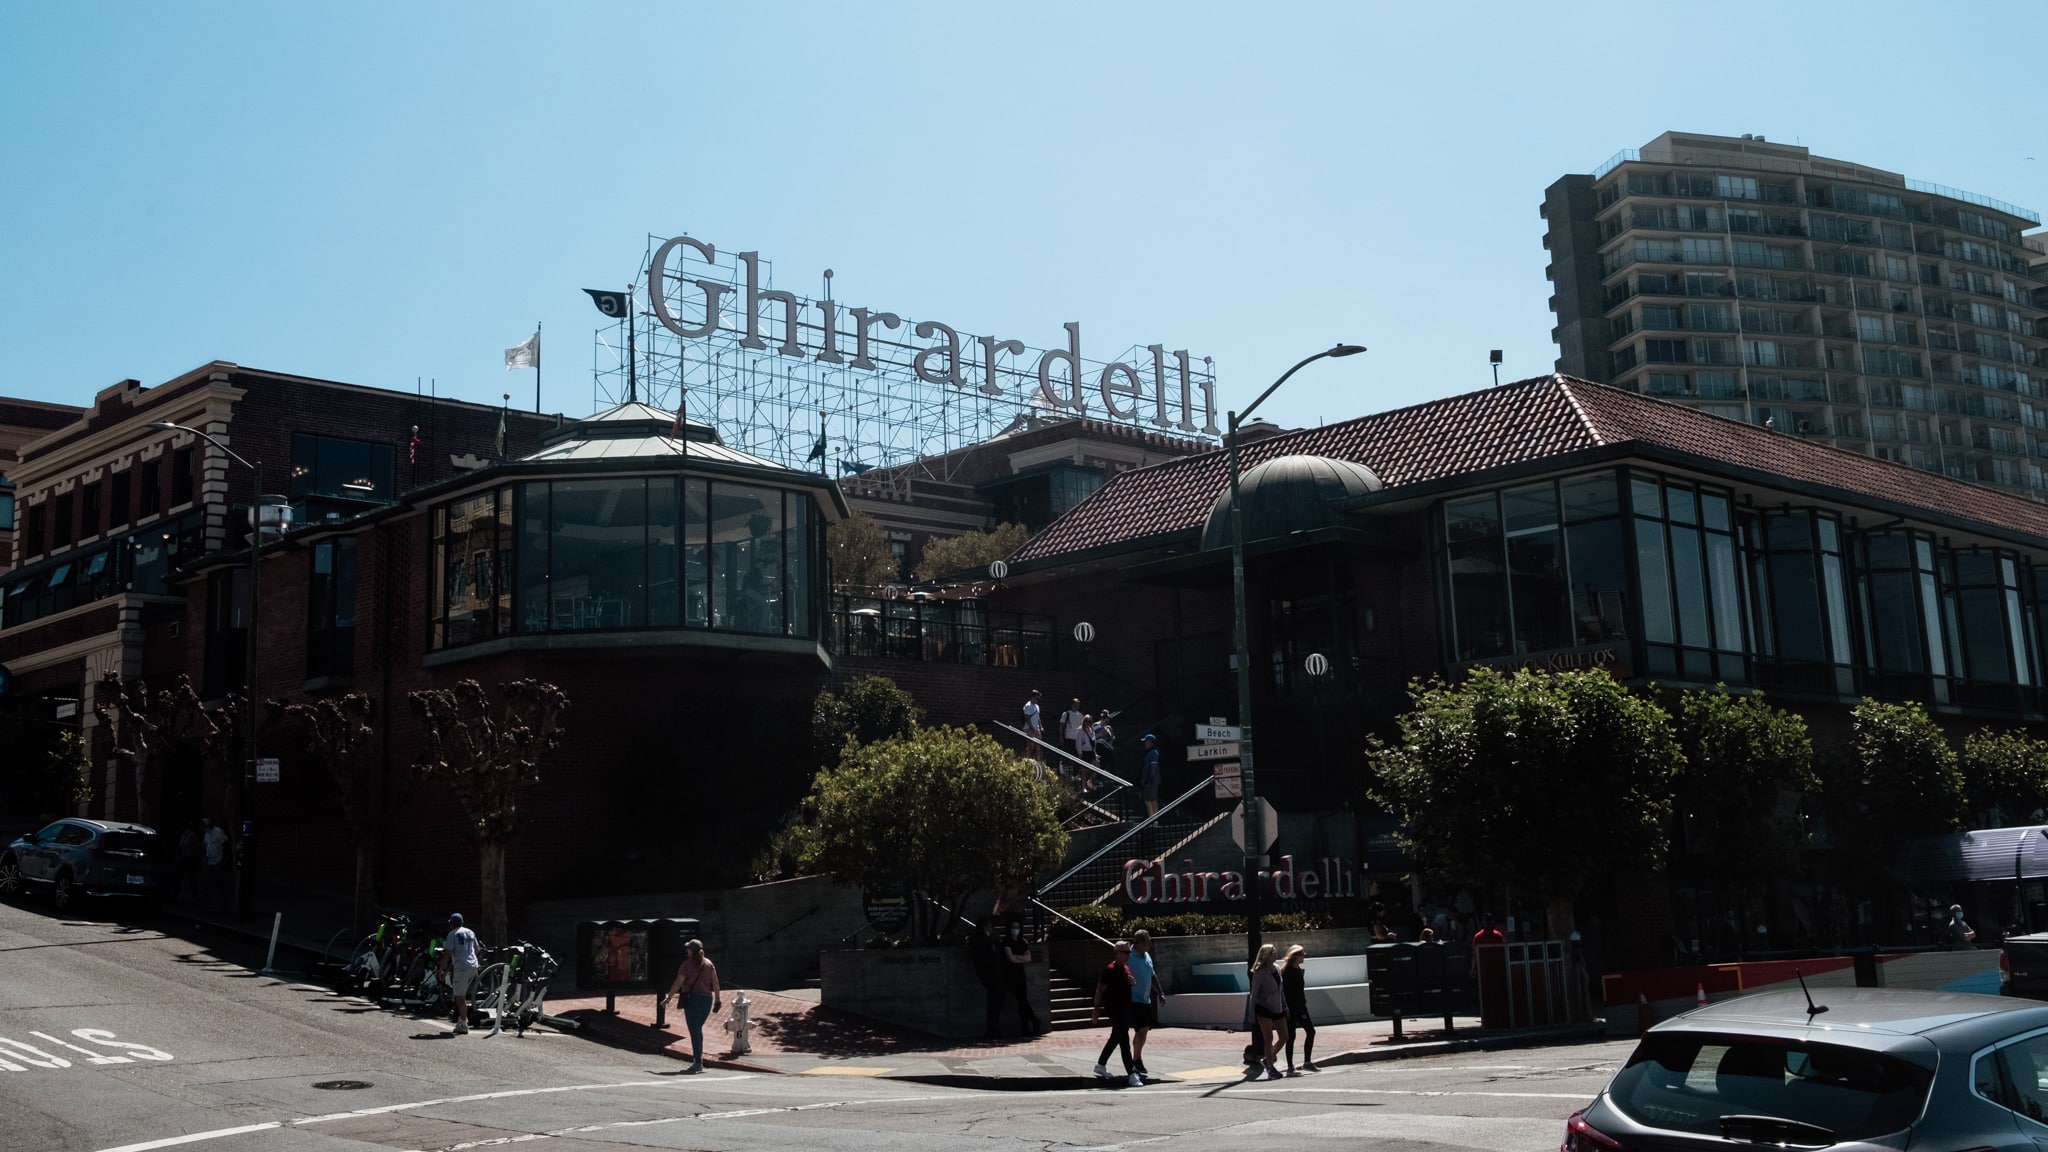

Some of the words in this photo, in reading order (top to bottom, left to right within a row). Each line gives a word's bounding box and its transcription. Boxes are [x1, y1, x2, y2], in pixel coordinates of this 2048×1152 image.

[648, 236, 1222, 436] Ghirardelli
[1207, 728, 1231, 738] Beach
[1198, 746, 1228, 757] Larkin
[1122, 853, 1356, 904] Ghiradelli
